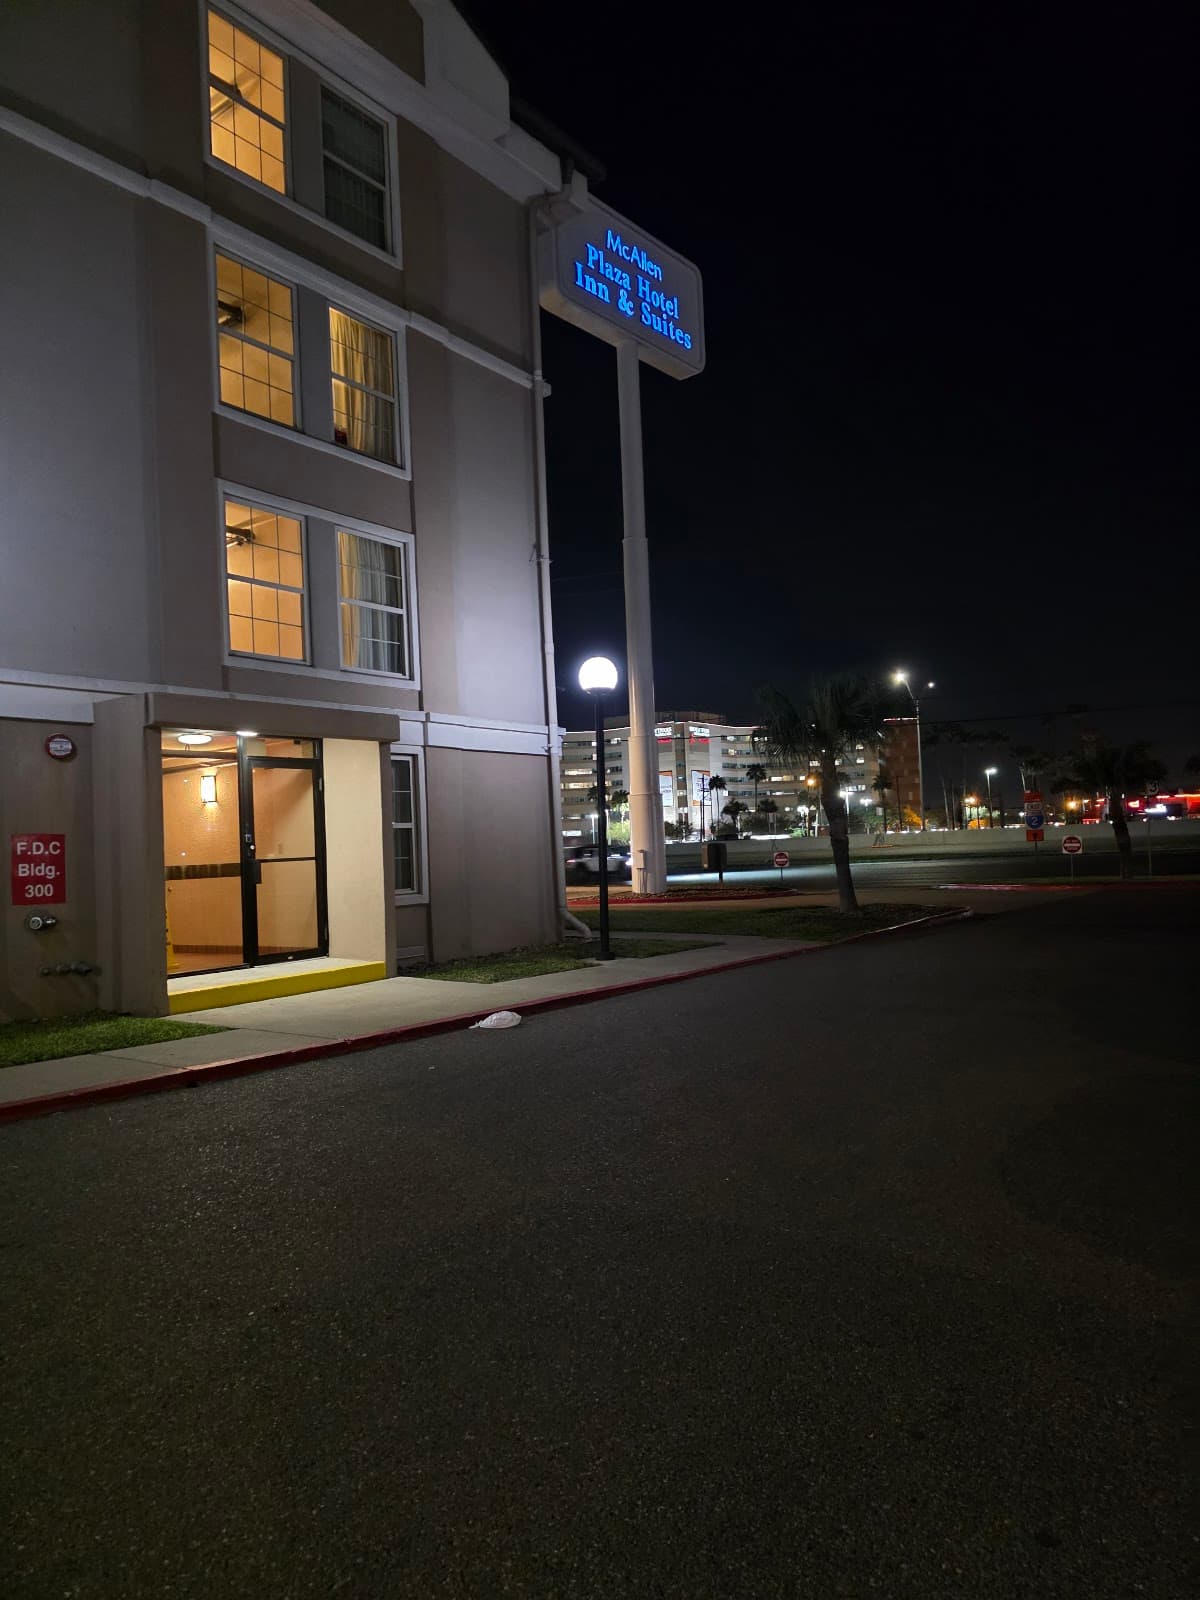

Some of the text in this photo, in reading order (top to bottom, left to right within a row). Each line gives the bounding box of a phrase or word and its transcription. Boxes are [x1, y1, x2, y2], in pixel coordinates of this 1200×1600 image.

[606, 229, 662, 282] McAllen
[586, 243, 680, 319] Plaza Hotel
[575, 262, 691, 349] Inn & Suites
[1031, 816, 1039, 826] 2
[16, 841, 61, 855] F.D.C
[18, 863, 60, 879] Bldg.
[25, 884, 53, 897] 300
